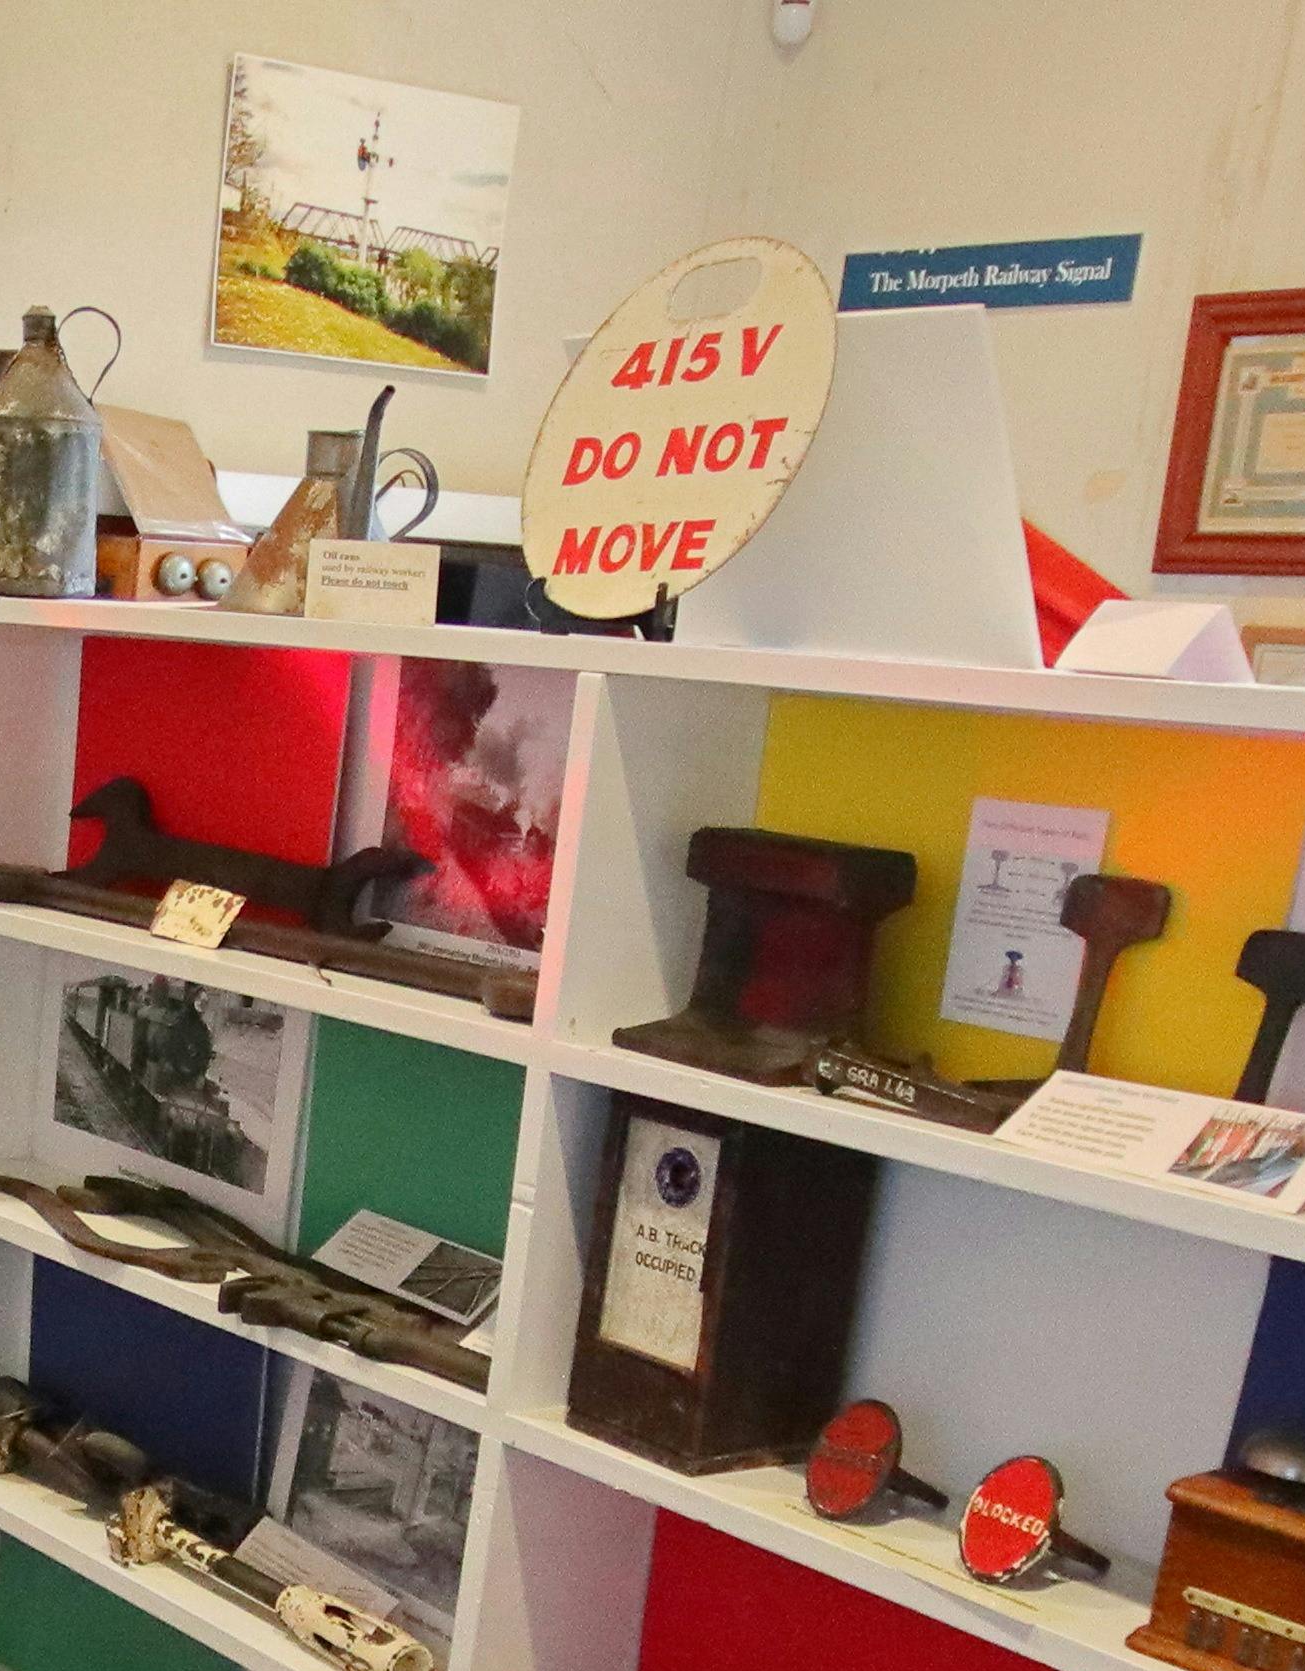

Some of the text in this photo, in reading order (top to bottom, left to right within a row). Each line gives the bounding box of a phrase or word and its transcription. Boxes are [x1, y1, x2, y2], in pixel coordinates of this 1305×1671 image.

[869, 257, 1114, 295] The Morpeth Railway Signal
[610, 324, 786, 391] 415 V
[562, 417, 790, 486] DO NOT
[552, 519, 718, 576] MOVE
[635, 1250, 696, 1283] OCCUPIED
